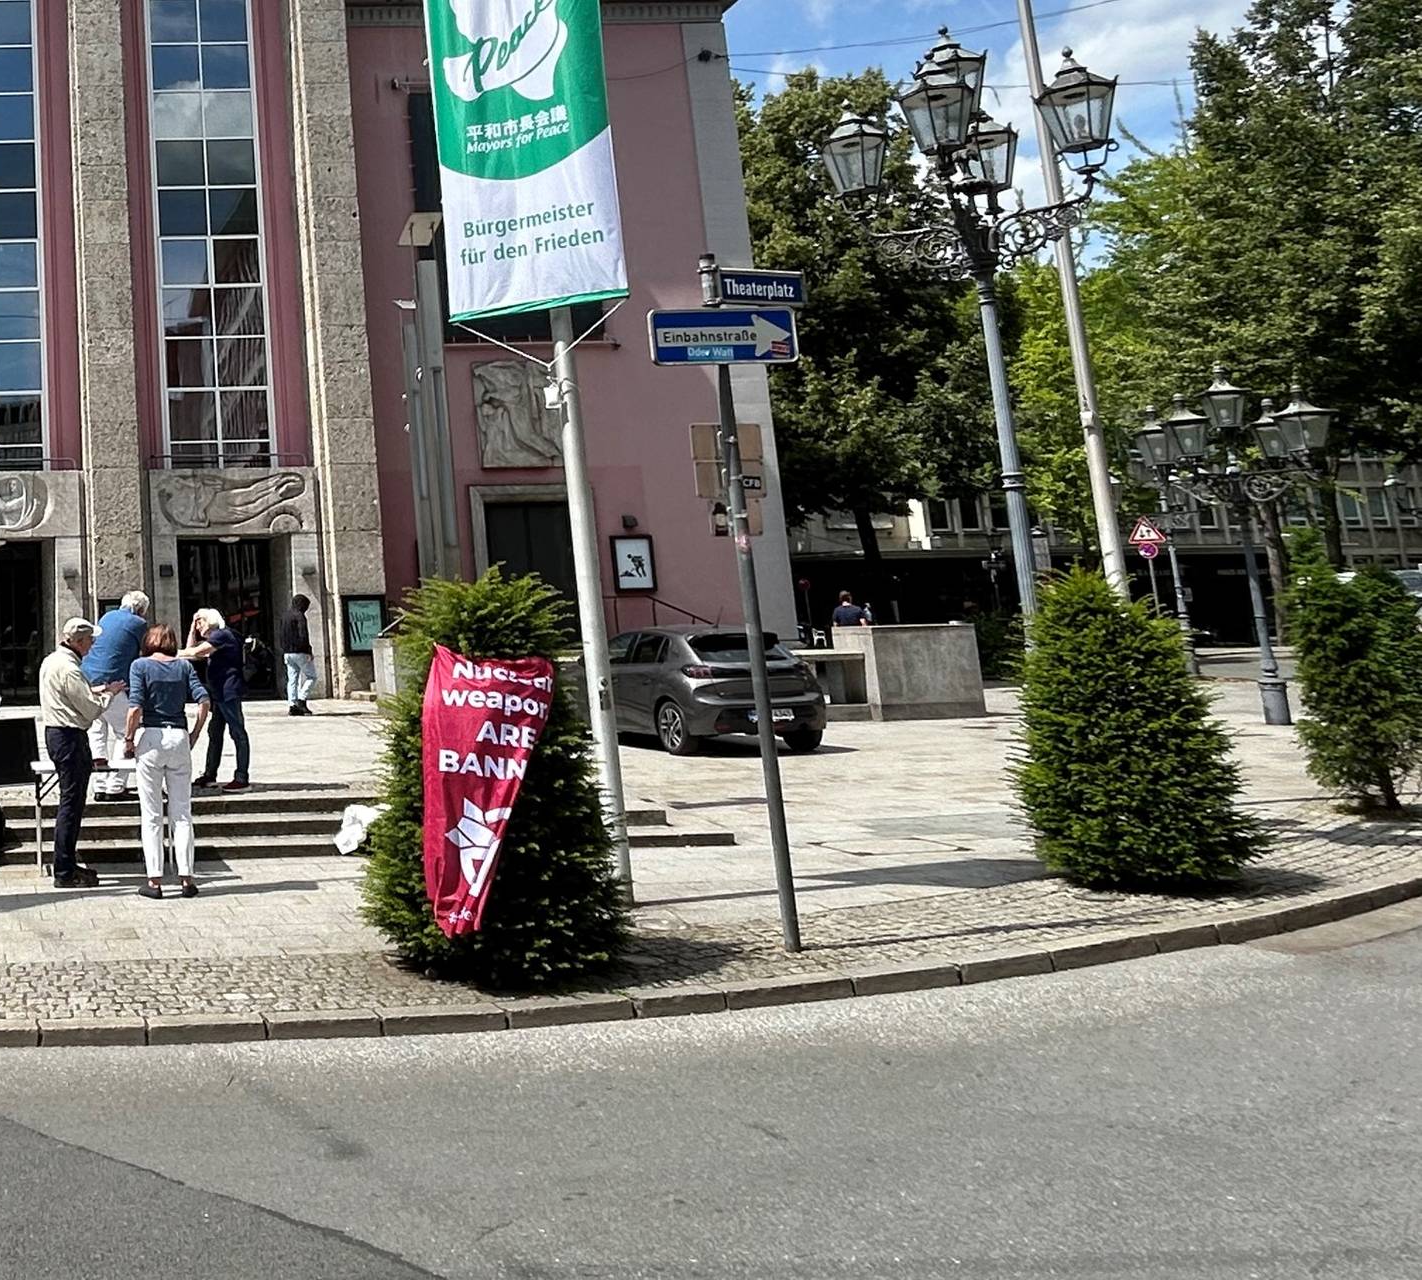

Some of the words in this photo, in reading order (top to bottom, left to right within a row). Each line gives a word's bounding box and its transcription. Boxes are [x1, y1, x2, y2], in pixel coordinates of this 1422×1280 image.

[466, 137, 513, 154] Mayors
[515, 131, 534, 148] for
[536, 122, 570, 139] Peace
[463, 202, 595, 238] Bürgermeister
[460, 248, 487, 266] für
[493, 242, 528, 261] den
[535, 229, 604, 254] Frieden
[723, 278, 795, 300] Theaterplatz
[663, 329, 757, 343] Einbahnstraße
[476, 720, 537, 750] ARE
